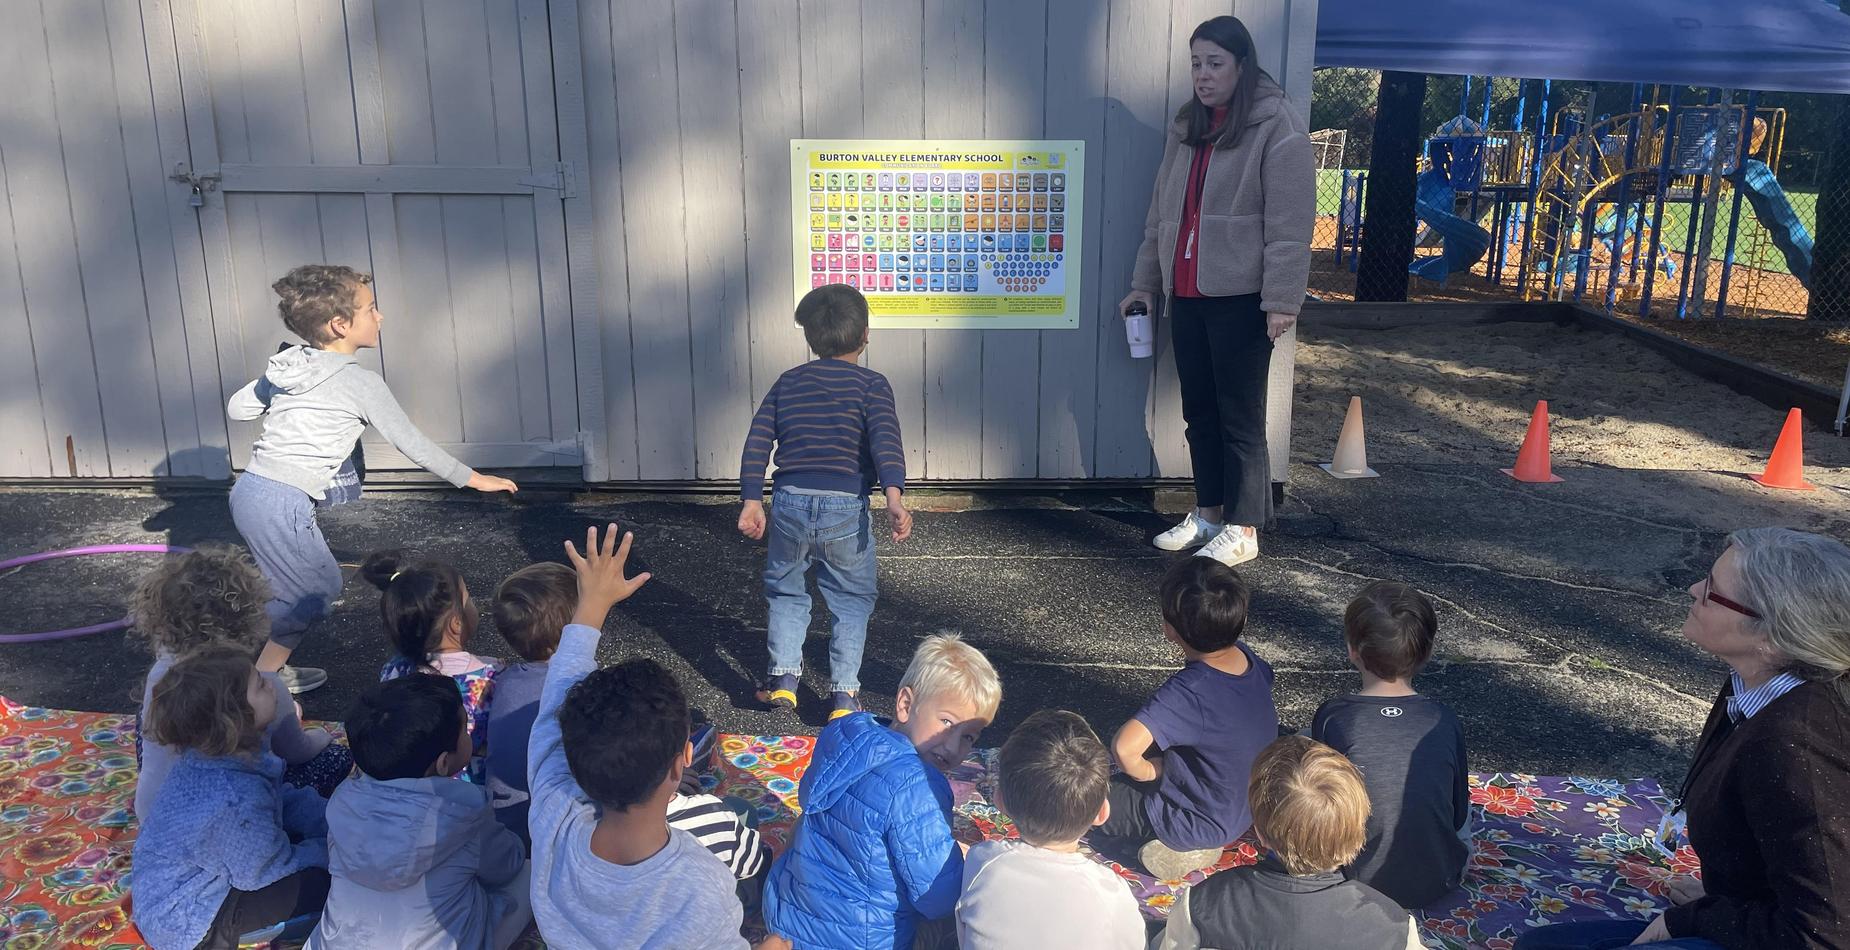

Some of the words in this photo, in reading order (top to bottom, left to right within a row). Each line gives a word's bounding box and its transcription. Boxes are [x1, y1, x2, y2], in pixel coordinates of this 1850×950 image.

[819, 153, 859, 162] BURTON
[861, 154, 897, 162] VALLEY
[899, 154, 962, 162] ELEMENTARY
[964, 154, 1004, 162] SCHOOL
